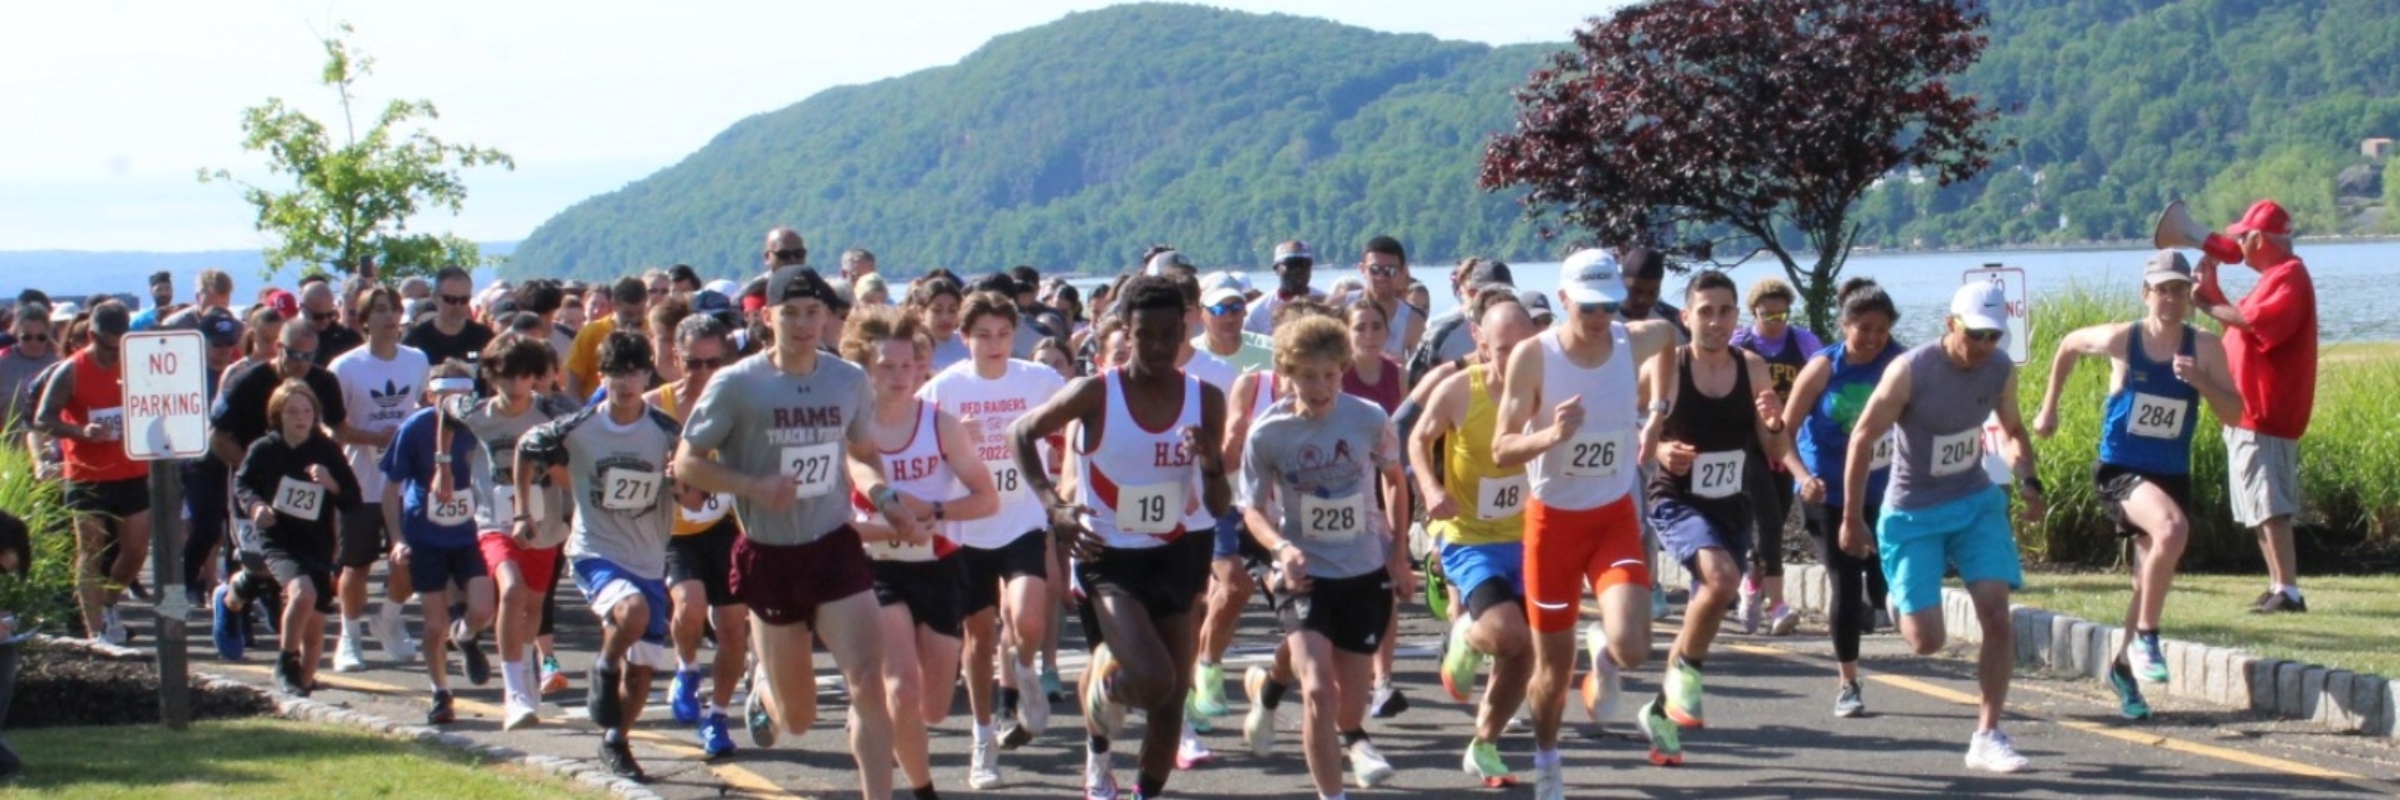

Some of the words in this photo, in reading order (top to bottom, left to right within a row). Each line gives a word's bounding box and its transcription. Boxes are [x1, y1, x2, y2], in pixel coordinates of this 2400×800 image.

[149, 352, 177, 375] NO
[130, 392, 200, 417] PARKING
[960, 401, 981, 415] RED
[983, 398, 1027, 414] RAIDERS
[773, 406, 842, 429] RAMS
[2138, 404, 2177, 429] 284
[766, 428, 806, 445] TRACK
[979, 445, 1011, 461] 2022
[1572, 441, 1616, 468] 226
[1941, 436, 1974, 466] 204
[791, 455, 830, 485] 227
[994, 468, 1018, 491] 18
[1702, 461, 1736, 488] 273
[285, 488, 316, 510] 123
[614, 479, 652, 500] 271
[1493, 485, 1519, 508] 48
[435, 499, 468, 516] 255
[1138, 495, 1166, 522] 19
[1312, 507, 1355, 531] 228
